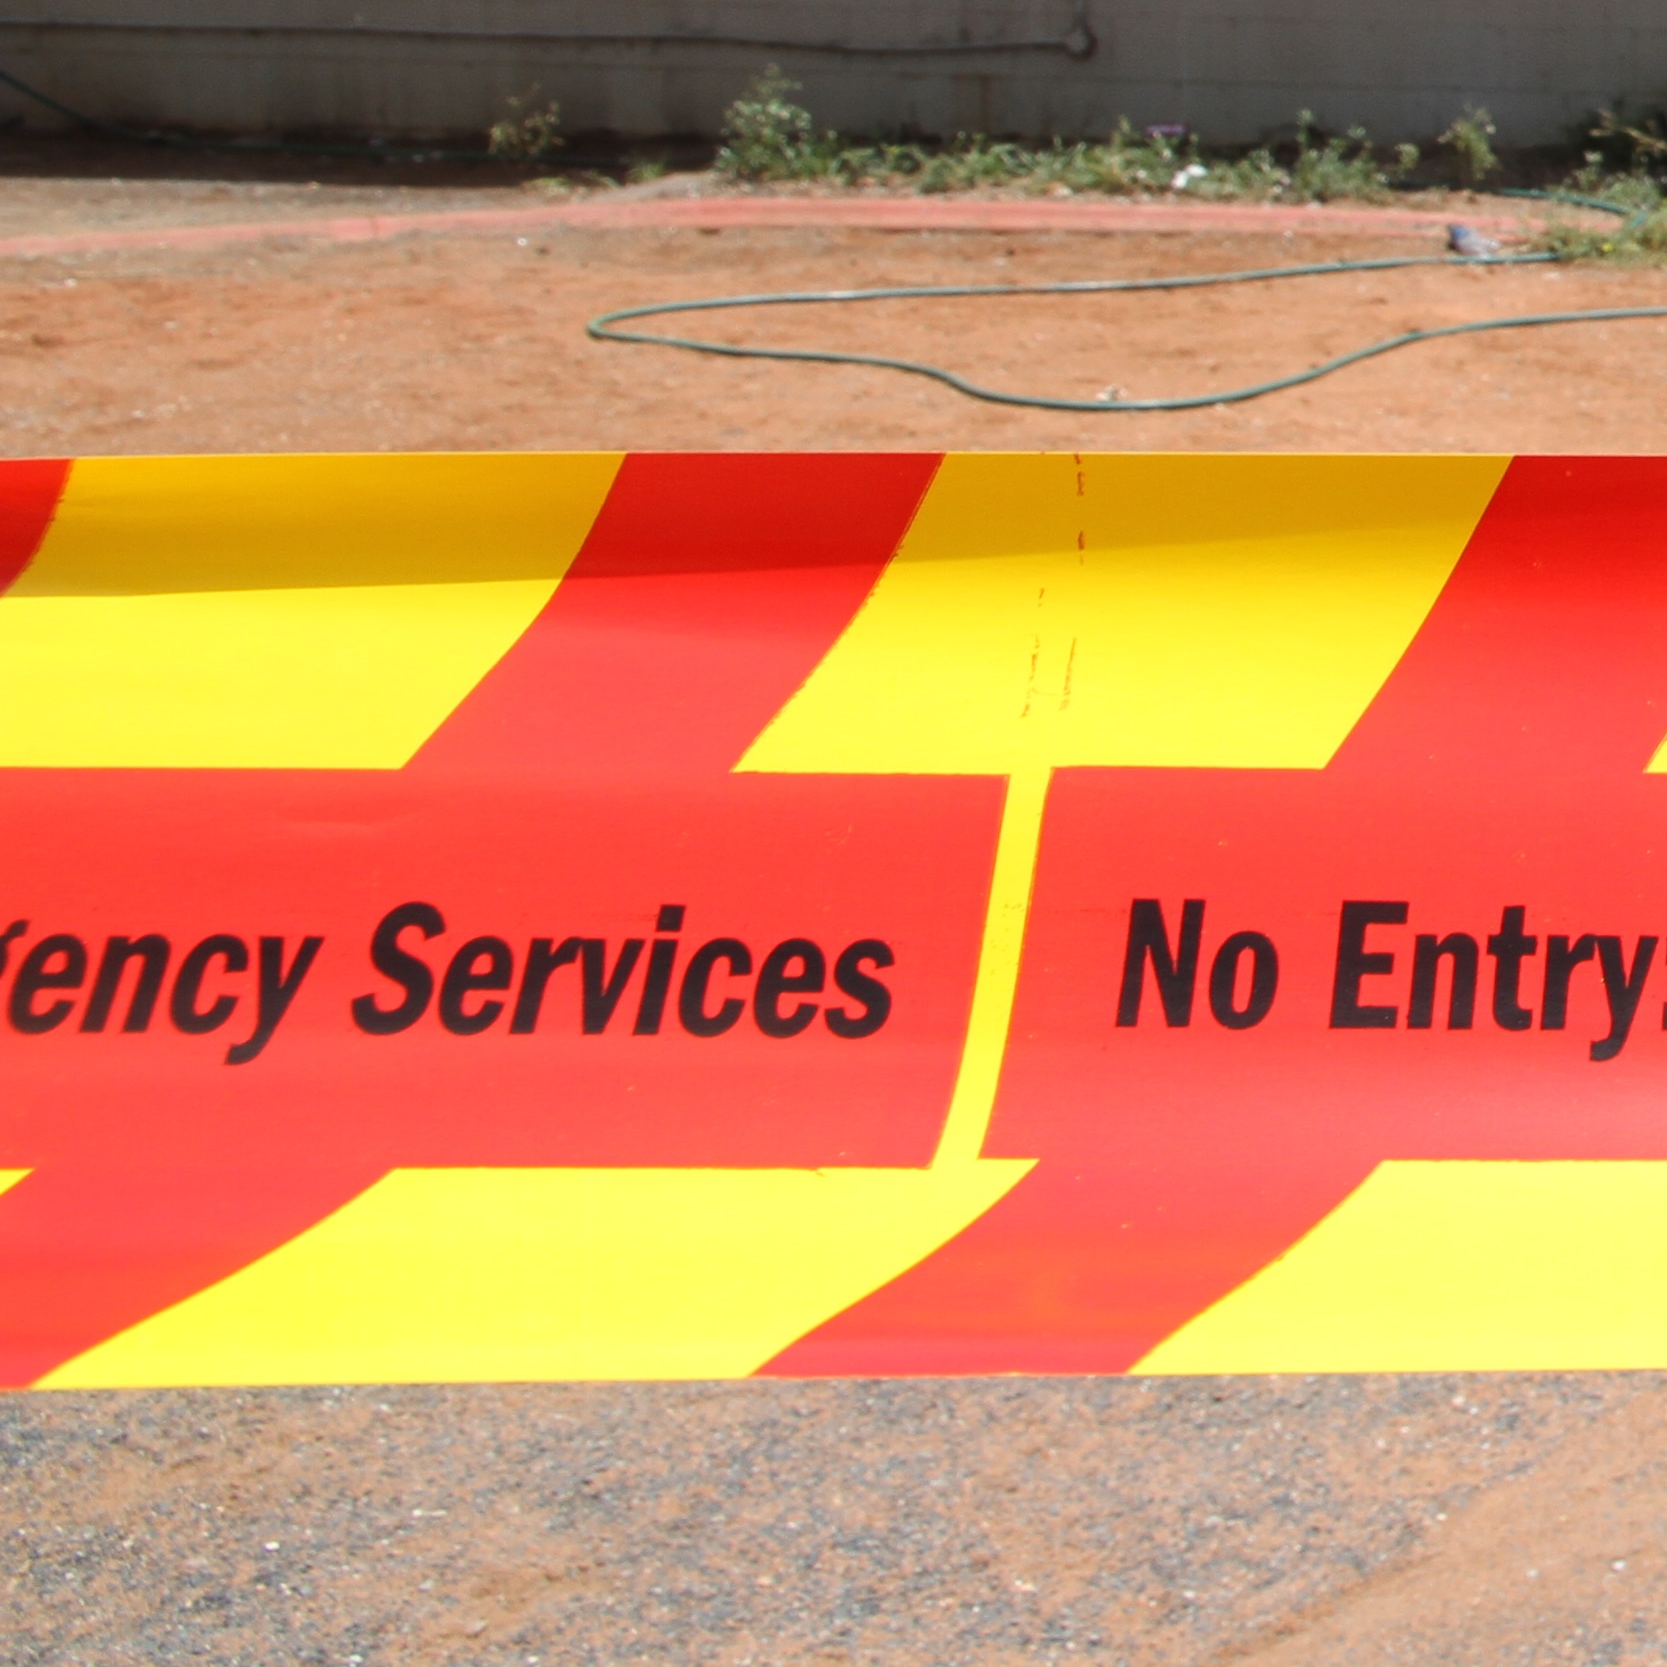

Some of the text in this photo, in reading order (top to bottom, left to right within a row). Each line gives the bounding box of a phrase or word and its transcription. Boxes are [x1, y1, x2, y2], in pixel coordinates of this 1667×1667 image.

[0, 901, 894, 1065] ency Services
[1116, 898, 1279, 1029] No
